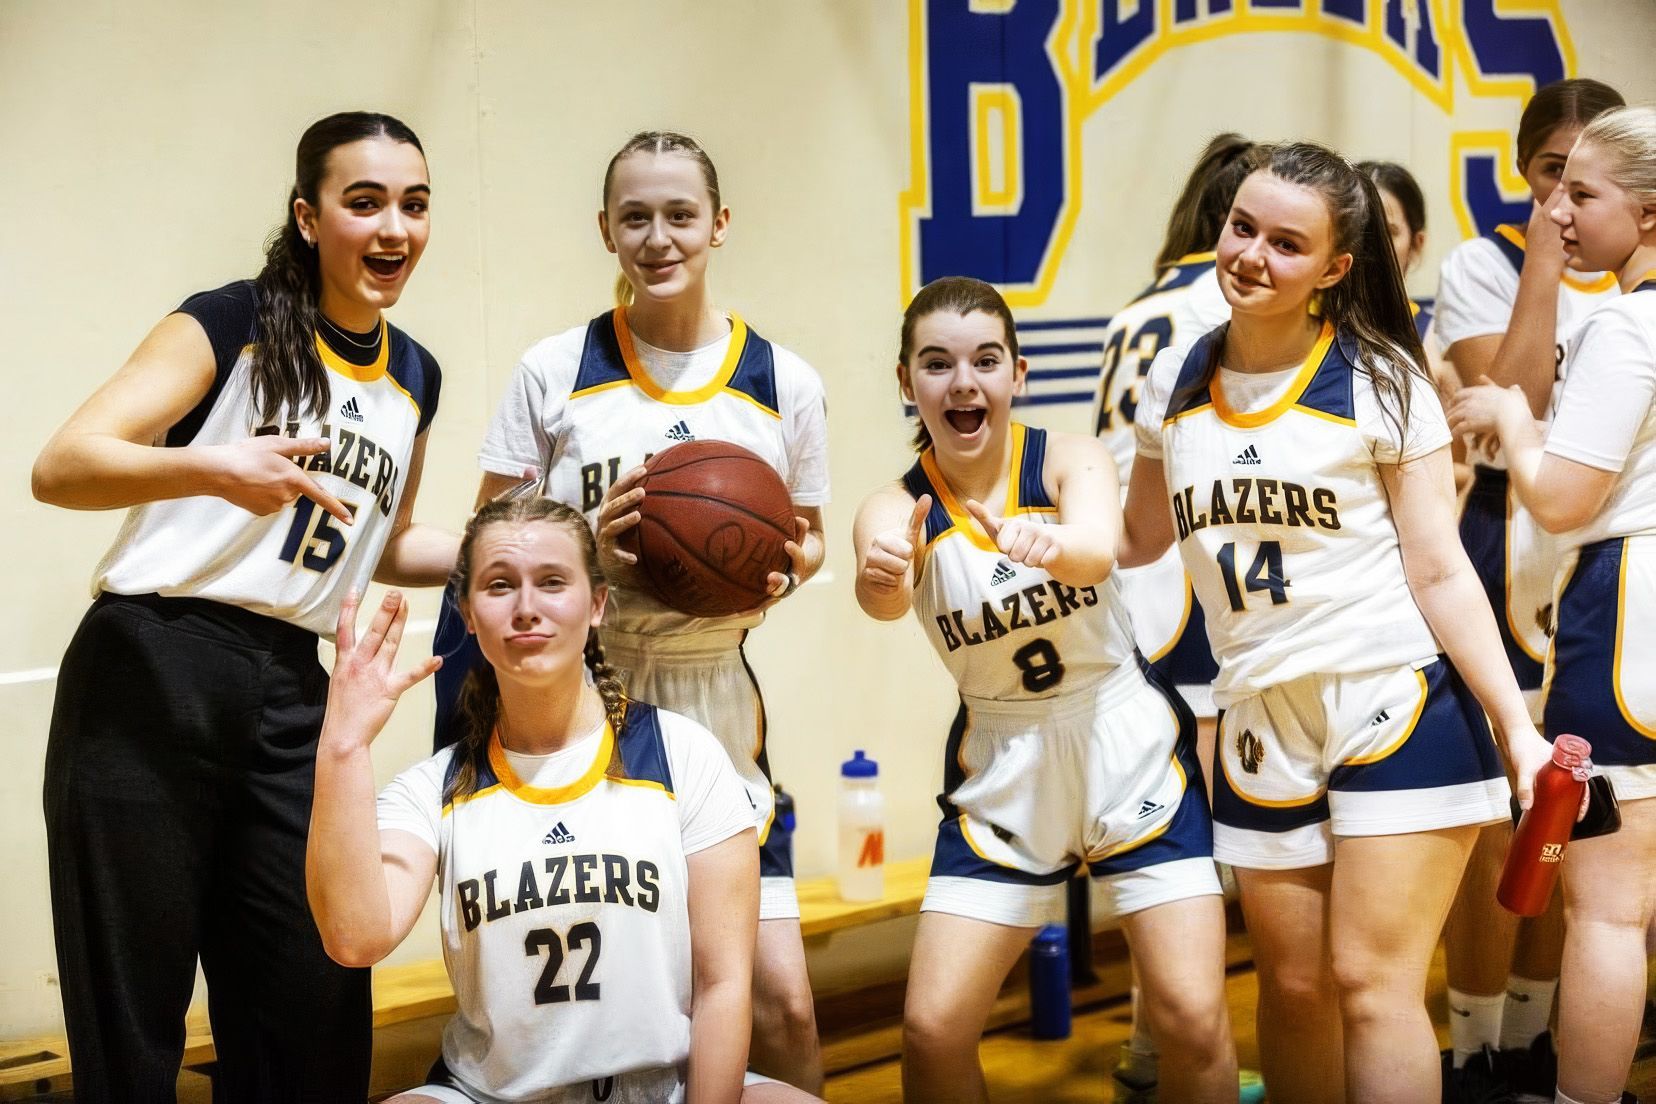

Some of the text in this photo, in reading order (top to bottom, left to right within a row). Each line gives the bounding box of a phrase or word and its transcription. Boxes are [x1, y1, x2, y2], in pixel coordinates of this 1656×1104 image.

[255, 424, 399, 518] AZERS
[1172, 478, 1342, 543] BLAZERS
[278, 494, 358, 573] 15
[1216, 540, 1292, 612] 14
[1012, 638, 1066, 693] 8
[456, 853, 661, 933] BLAZERS
[524, 921, 601, 1005] 22
